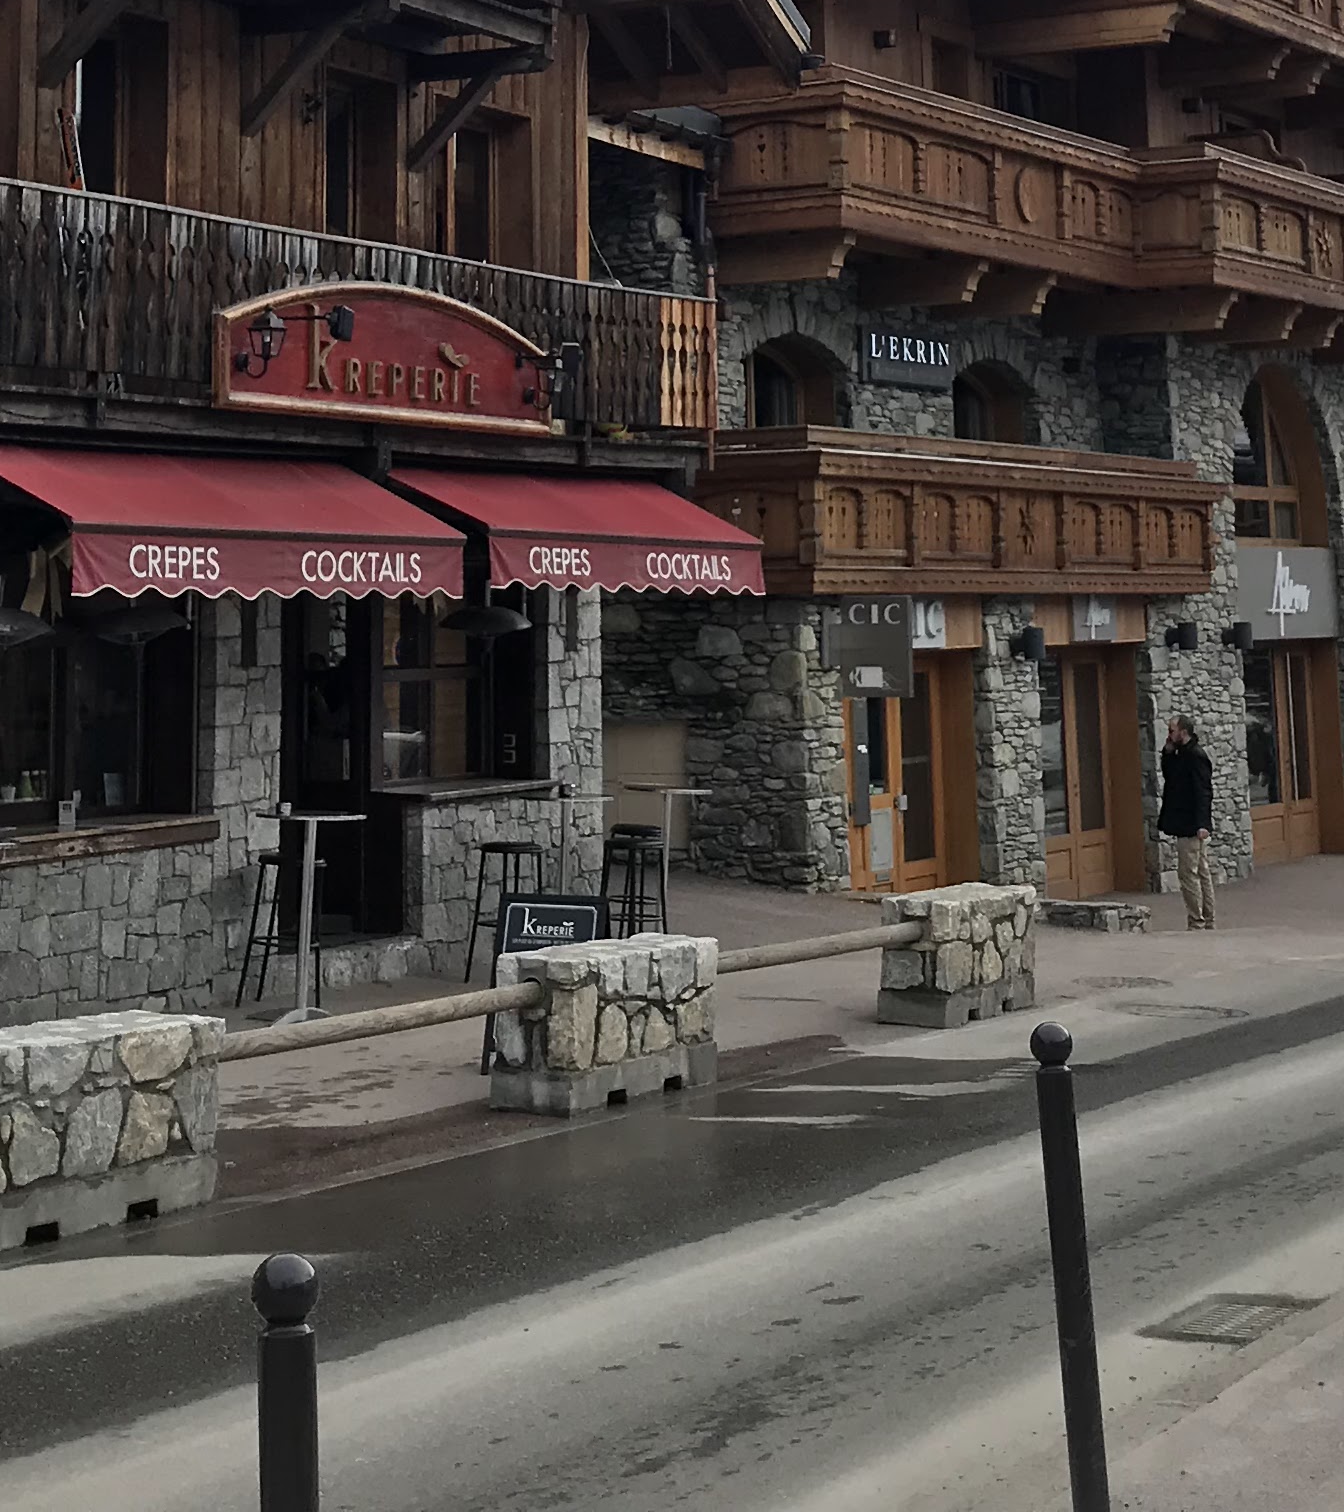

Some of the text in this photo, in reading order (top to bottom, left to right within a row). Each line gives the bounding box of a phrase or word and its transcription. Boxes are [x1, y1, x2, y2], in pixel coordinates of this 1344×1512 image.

[870, 333, 950, 366] L'EKRIN
[128, 544, 422, 583] CREPES COCKTAILS
[529, 546, 732, 581] CREPES COCKTAILS
[848, 603, 901, 624] CIC
[913, 601, 945, 639] IC
